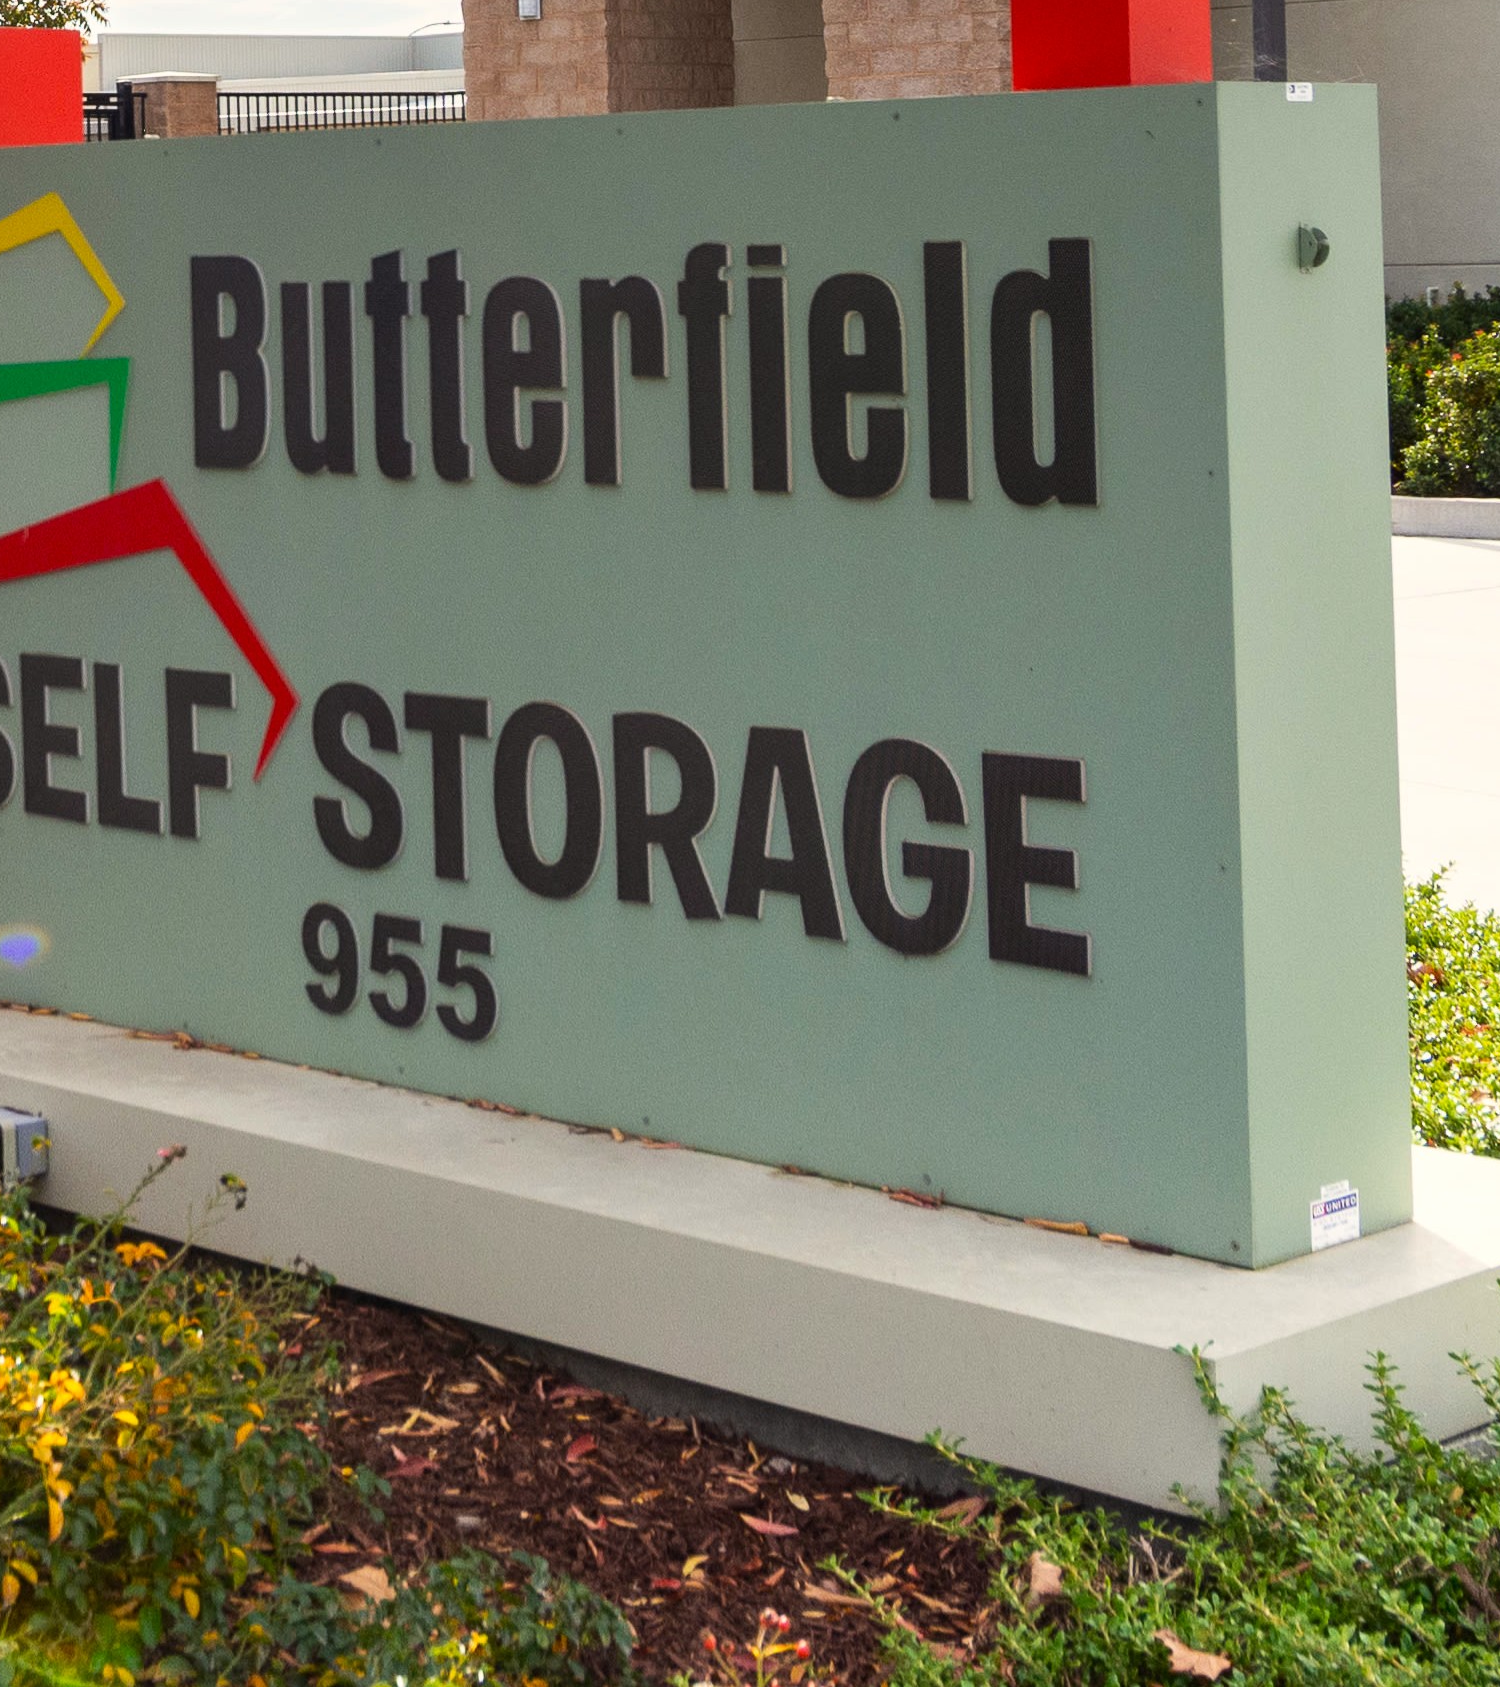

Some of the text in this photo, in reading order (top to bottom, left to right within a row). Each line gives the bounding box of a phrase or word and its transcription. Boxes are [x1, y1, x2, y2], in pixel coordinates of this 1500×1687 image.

[188, 235, 1101, 512] Butterfield
[310, 680, 1092, 980] STORAGE
[300, 901, 500, 1045] 955
